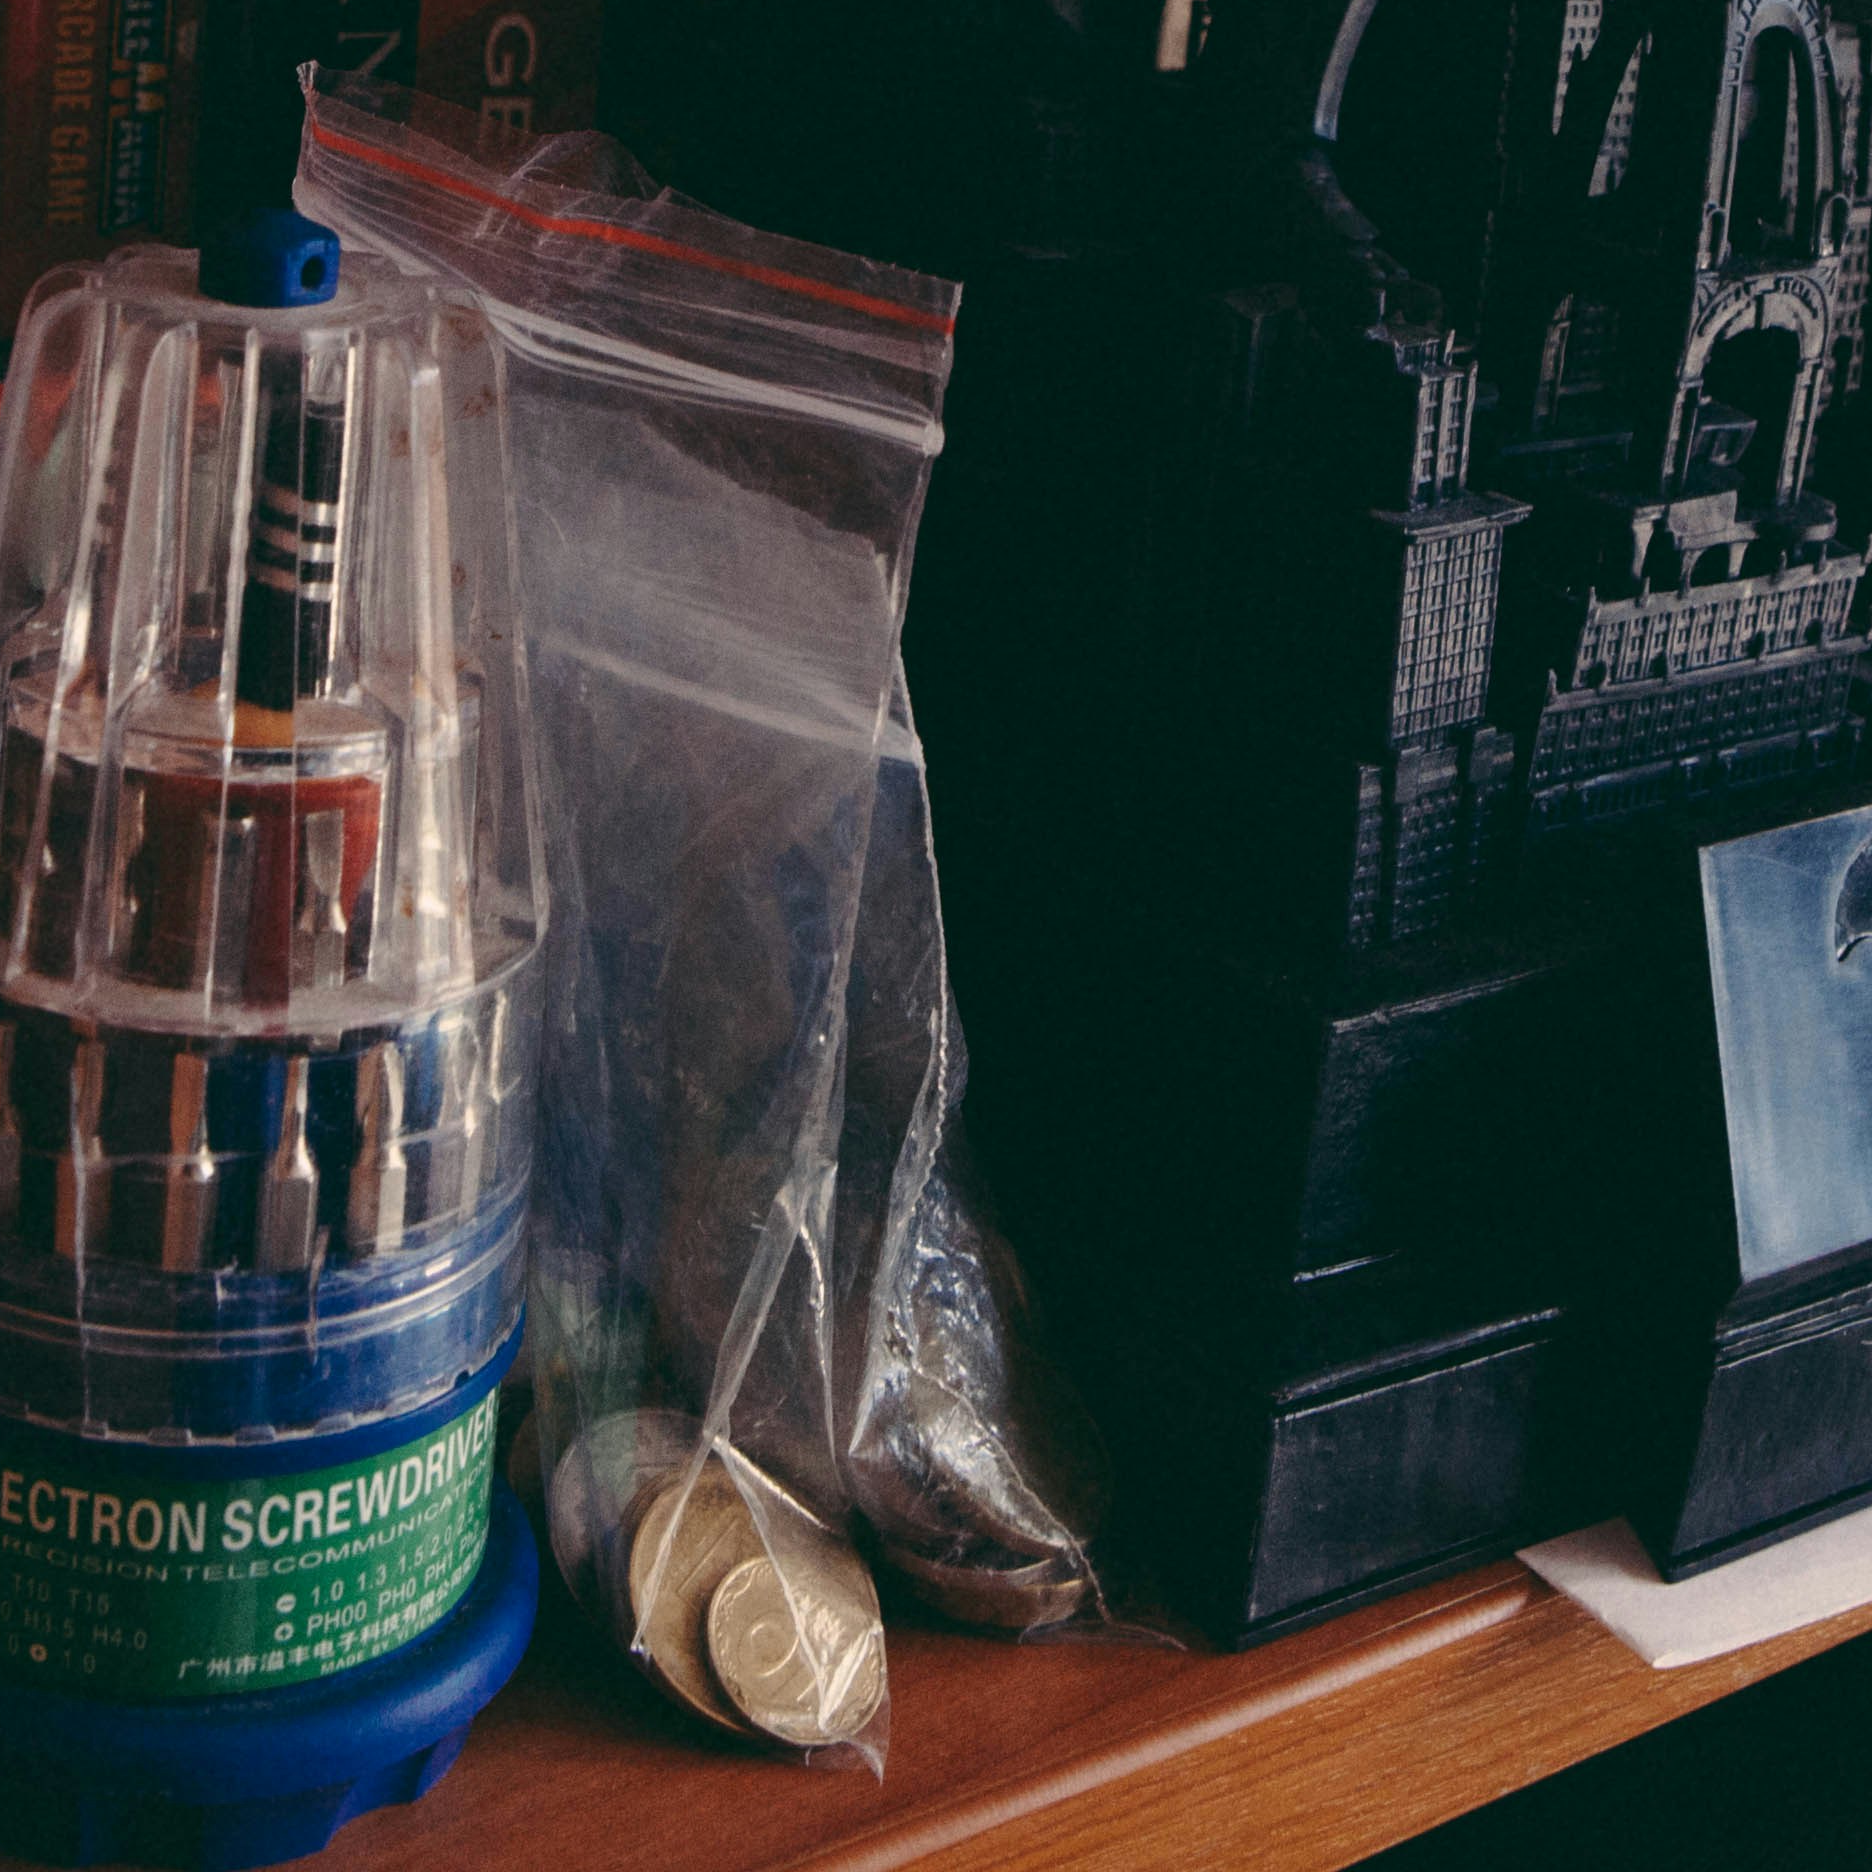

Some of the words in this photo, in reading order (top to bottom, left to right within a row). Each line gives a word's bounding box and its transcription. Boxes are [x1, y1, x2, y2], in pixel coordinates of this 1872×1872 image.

[46, 124, 93, 228] GAME
[220, 1386, 496, 1552] SCREWDRIVER
[305, 1600, 368, 1638] PH00
[377, 1576, 417, 1614] PH0
